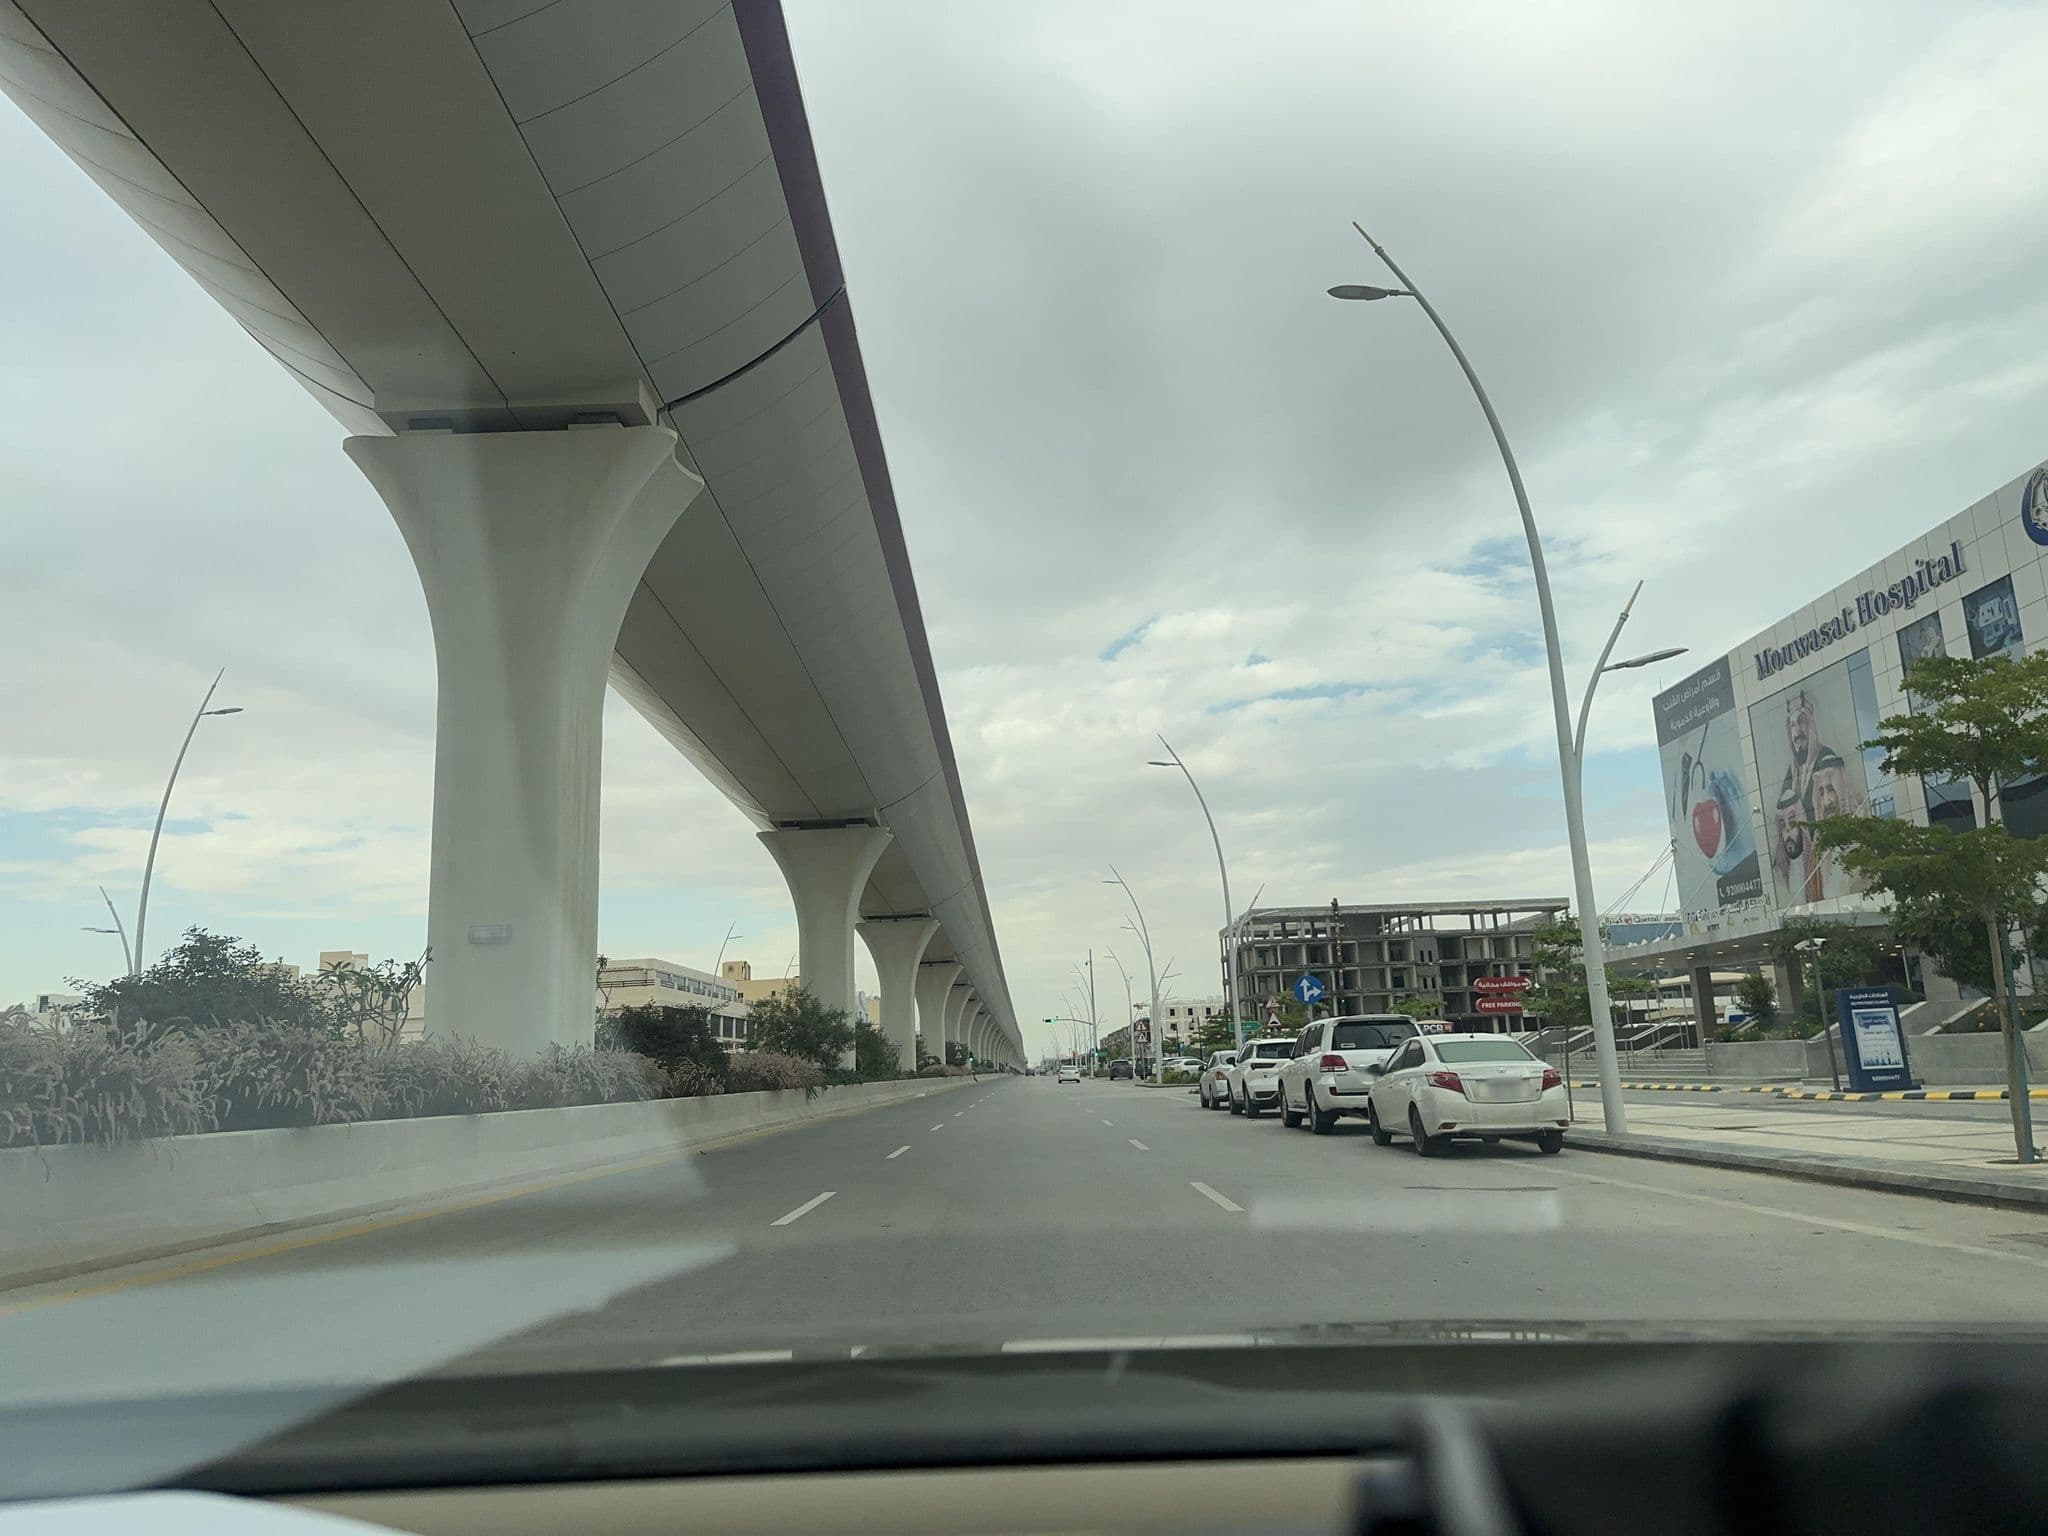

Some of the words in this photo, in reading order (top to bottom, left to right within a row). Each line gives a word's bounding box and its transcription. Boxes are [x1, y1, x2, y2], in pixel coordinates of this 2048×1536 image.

[1754, 607, 1857, 681] Mouwasat
[1854, 539, 1967, 611] Hospital
[1701, 668, 1720, 692] قسم
[1423, 1024, 1444, 1033] PCR
